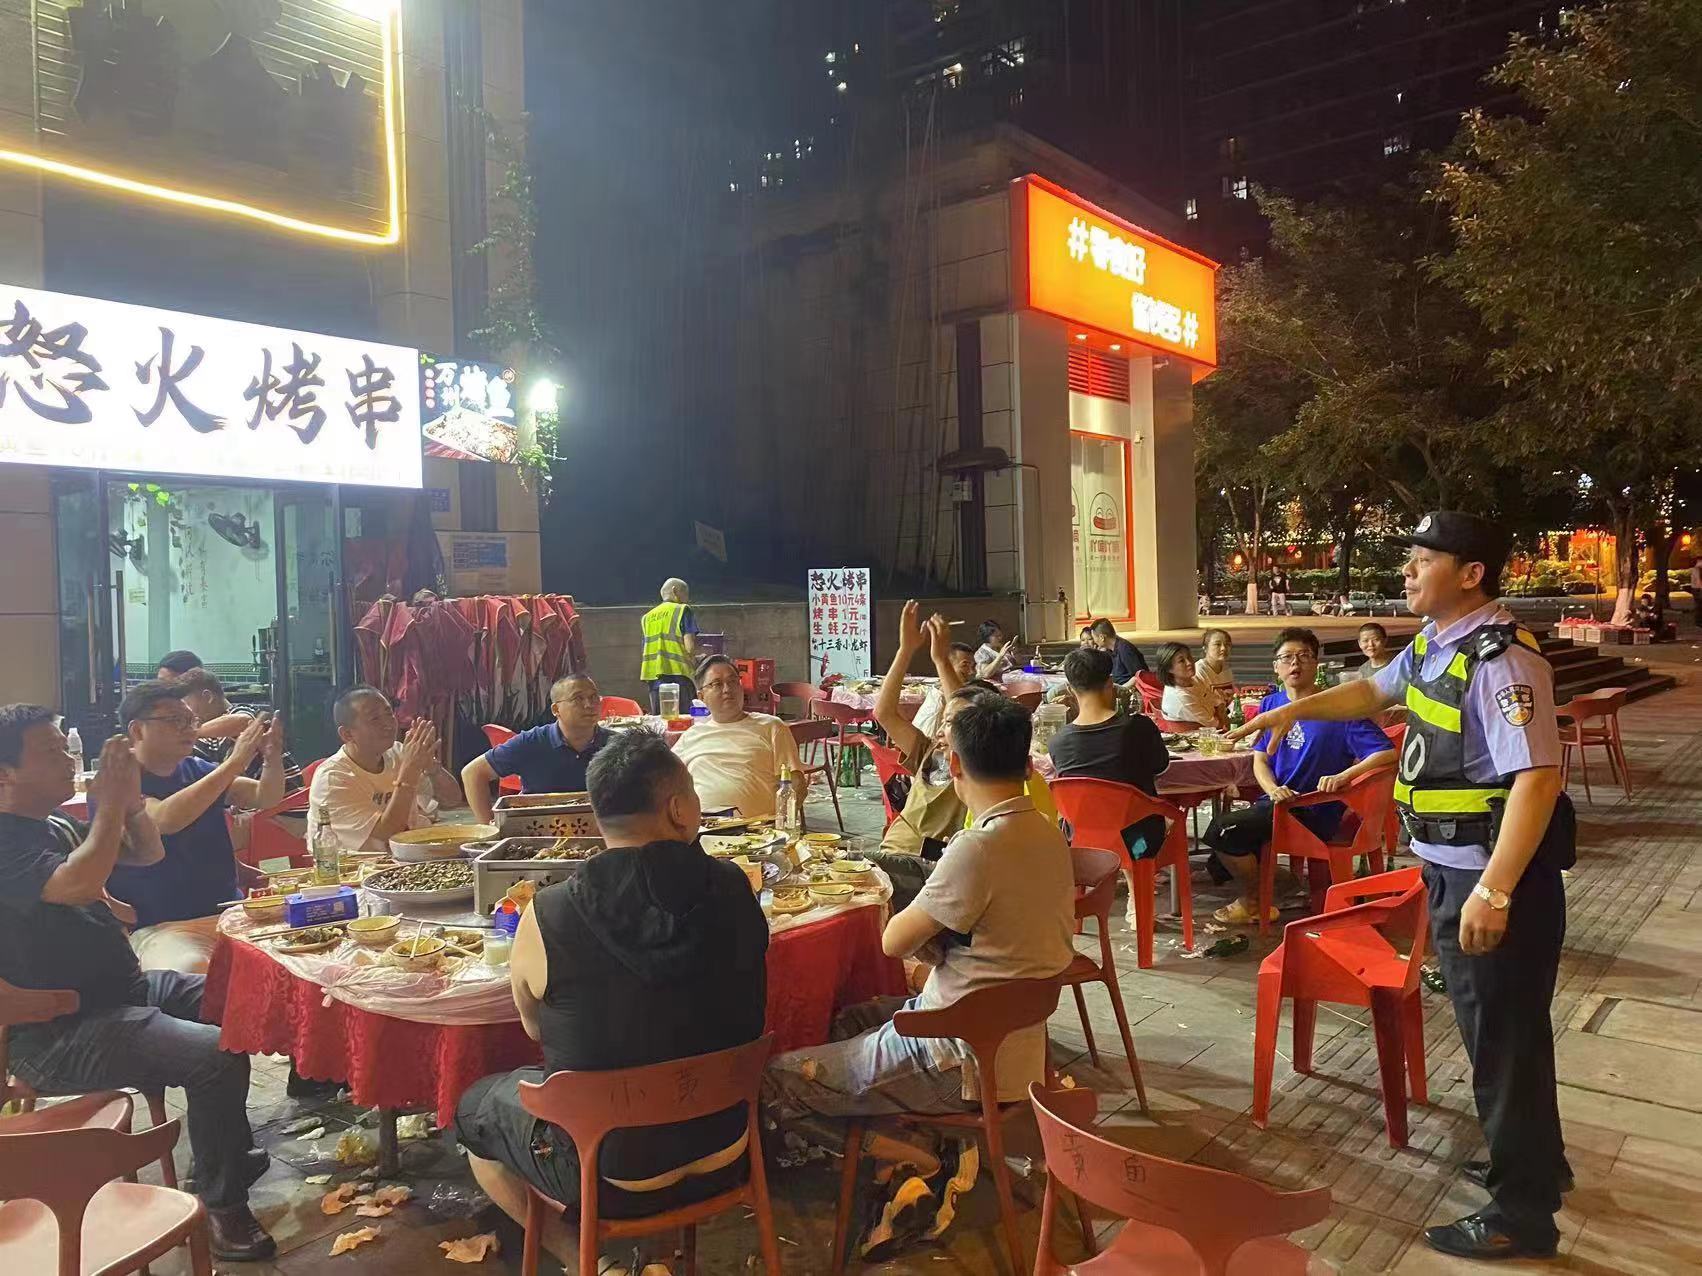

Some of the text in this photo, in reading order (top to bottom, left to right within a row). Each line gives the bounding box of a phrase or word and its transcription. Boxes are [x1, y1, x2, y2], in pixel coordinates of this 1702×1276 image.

[0, 299, 403, 449] 怒火烤串
[810, 571, 868, 592] 怒火烤串
[812, 593, 867, 606] 小黄鱼10元4条
